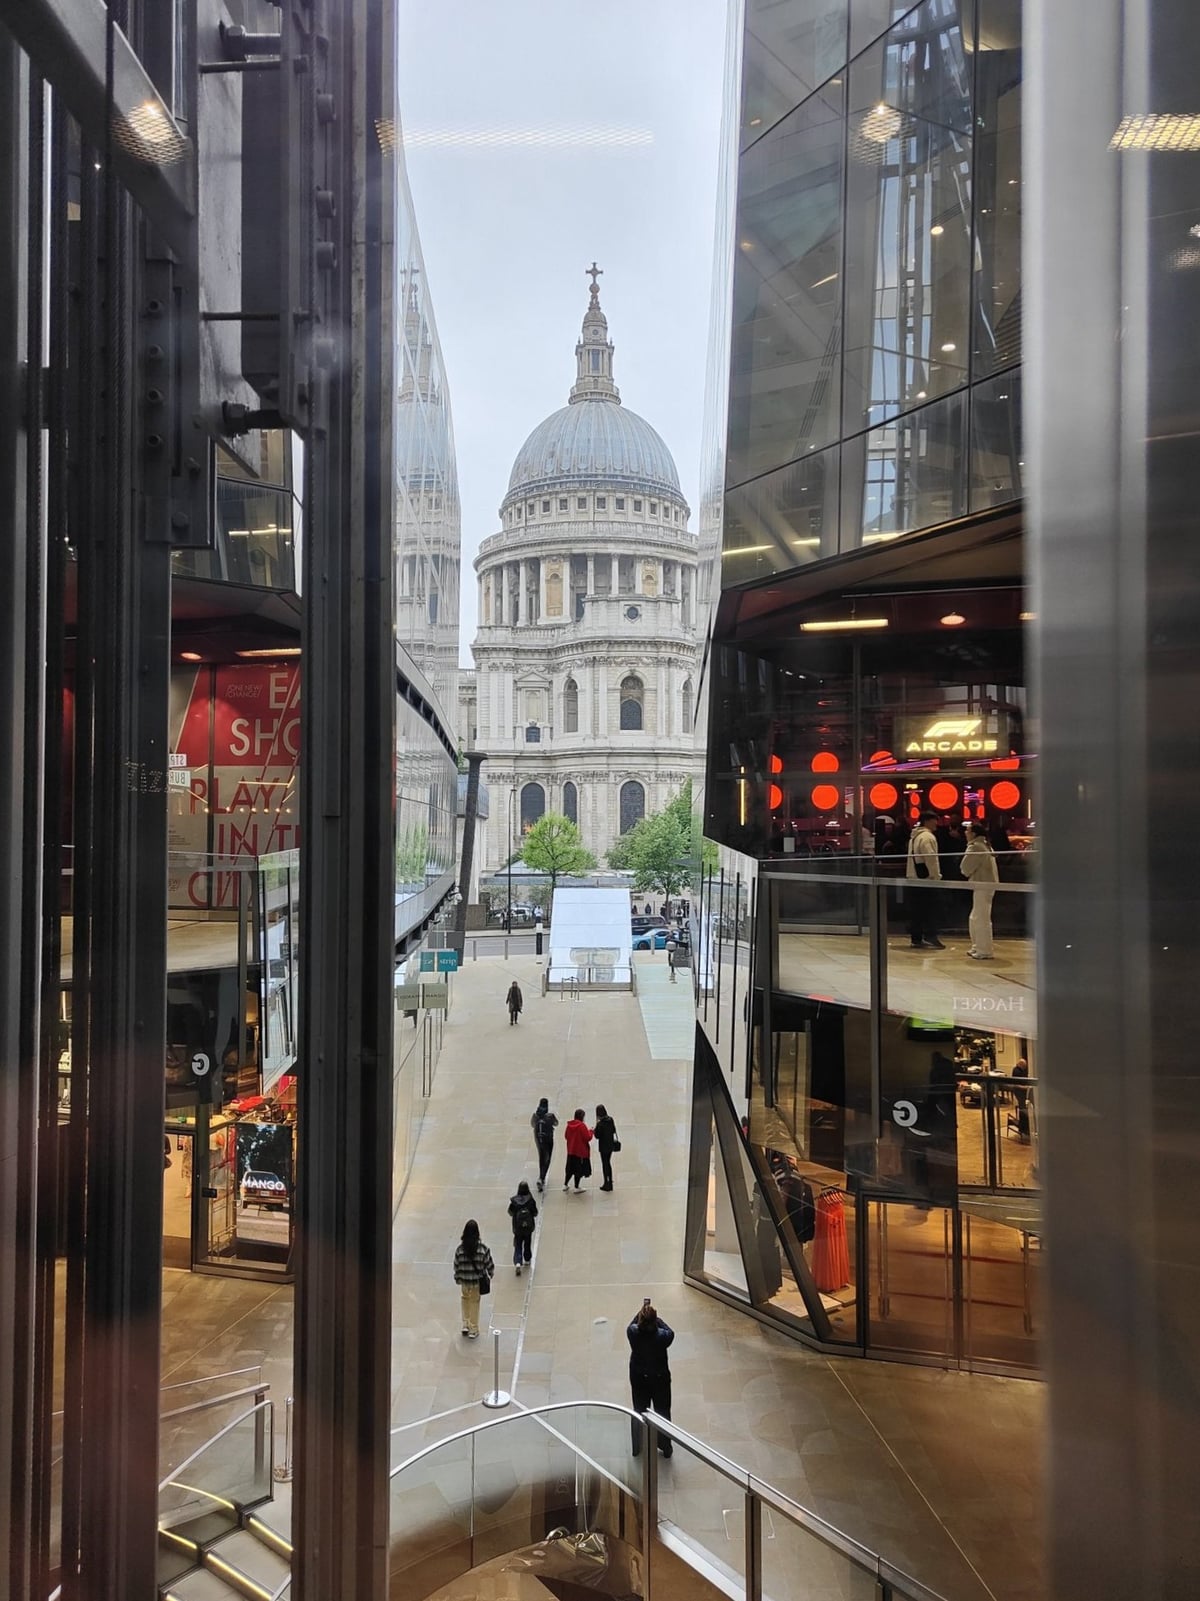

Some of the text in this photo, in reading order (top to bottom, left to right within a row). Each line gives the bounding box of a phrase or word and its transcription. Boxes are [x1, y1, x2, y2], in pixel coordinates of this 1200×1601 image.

[906, 740, 998, 752] ARCADE
[189, 777, 280, 814] PLAY
[218, 823, 258, 860] IN
[242, 1176, 285, 1191] MANGO
